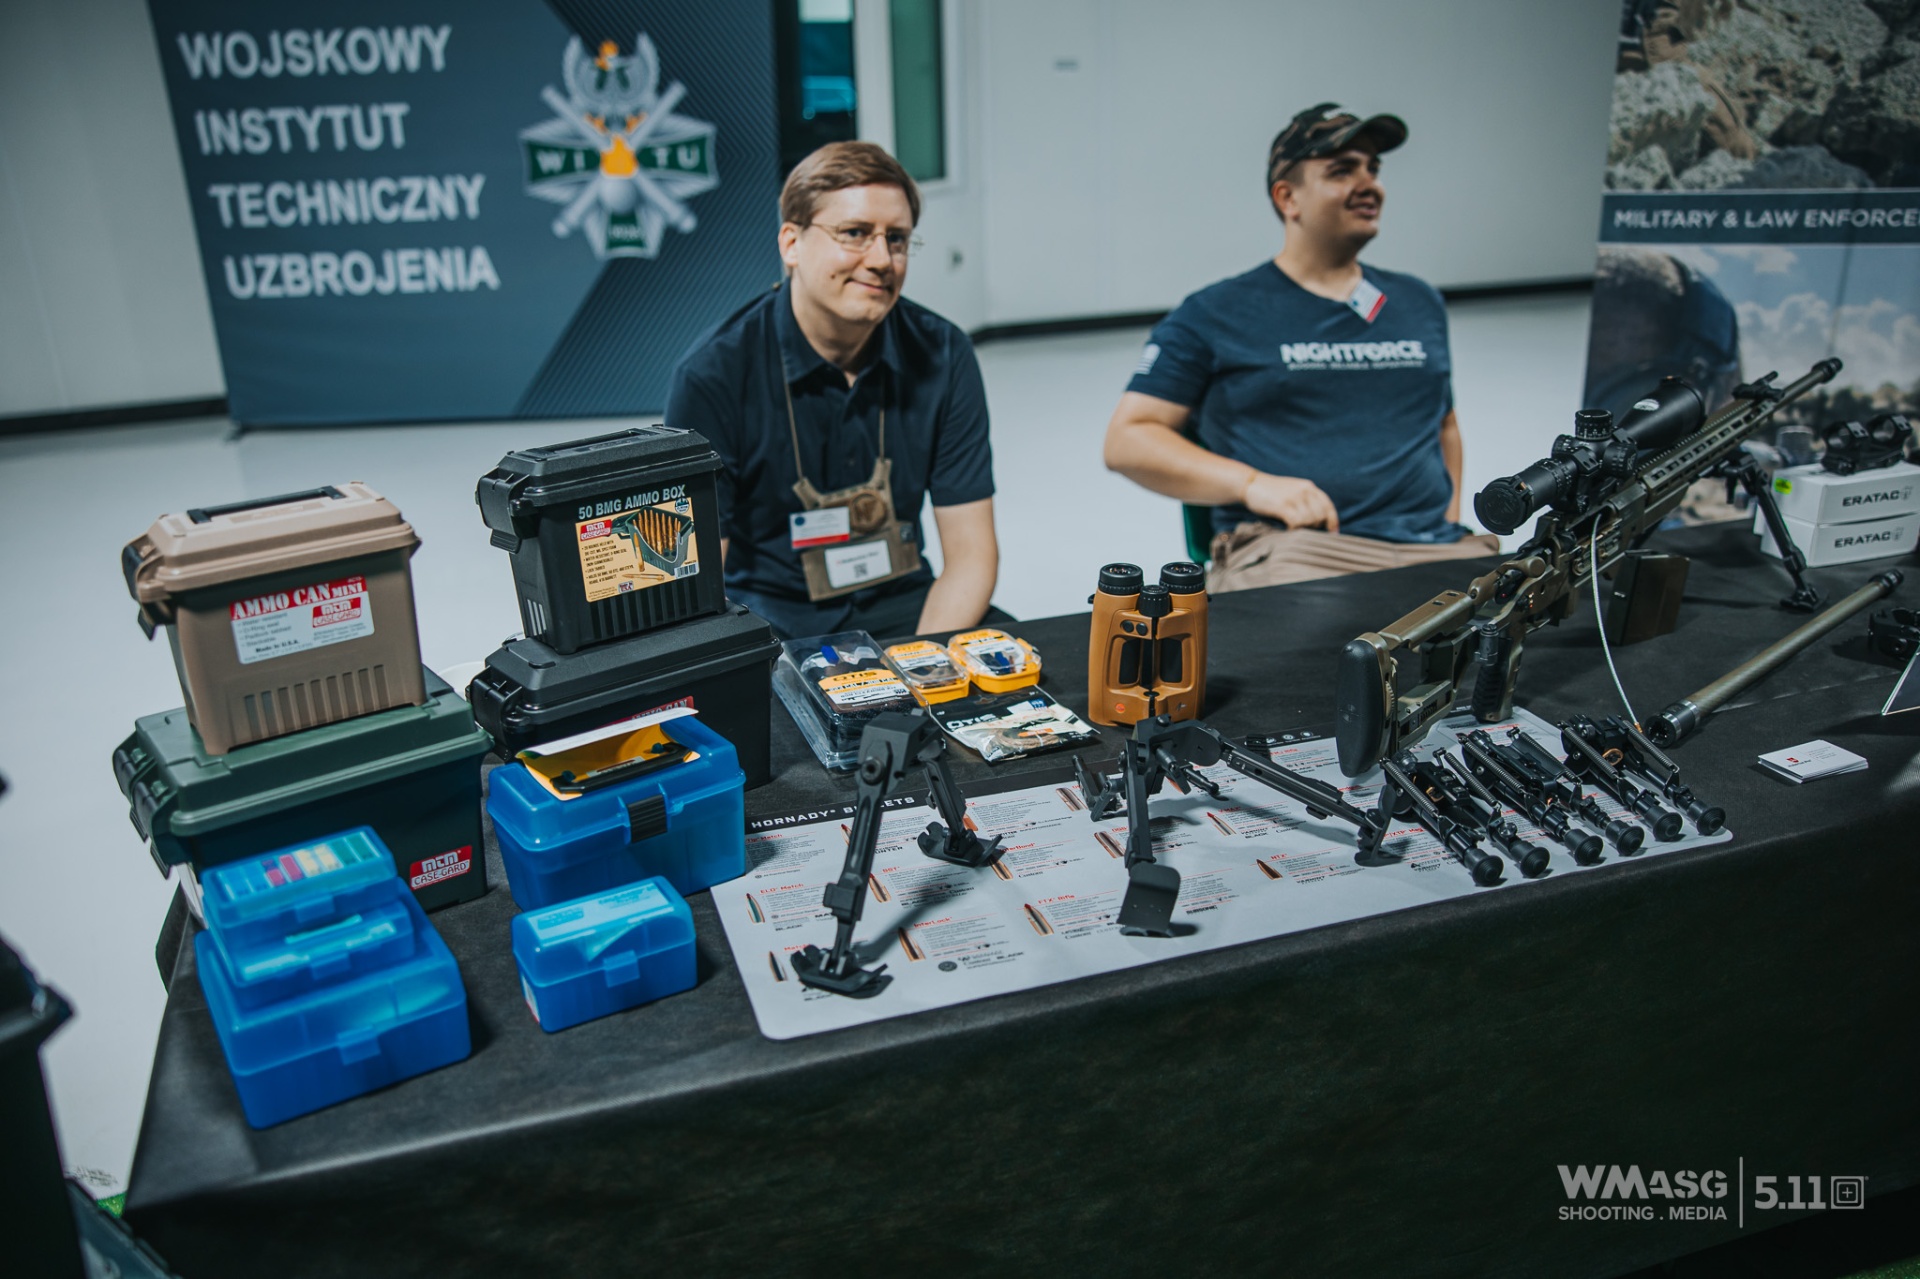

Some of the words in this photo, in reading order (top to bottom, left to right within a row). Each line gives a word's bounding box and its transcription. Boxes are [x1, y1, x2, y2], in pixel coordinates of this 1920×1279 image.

[177, 24, 451, 79] WOJSKOWY
[194, 102, 410, 155] INSTYTUT
[208, 173, 486, 229] TECHNICZNY
[1613, 209, 1718, 229] MILITARY
[1722, 209, 1739, 229] &
[1744, 209, 1799, 229] LAW
[1804, 207, 1920, 228] ENFORCE
[223, 246, 500, 300] UZBROJENIA
[1280, 340, 1427, 364] NIGHTFORCE
[578, 506, 593, 520] 50
[595, 499, 622, 516] BMG
[625, 490, 660, 510] AMMO
[662, 484, 686, 500] BOX
[1842, 490, 1900, 507] ERATAC
[1834, 531, 1891, 548] ERATAC
[233, 593, 289, 620] AMMO
[293, 583, 331, 606] CAN
[332, 582, 363, 598] MINI
